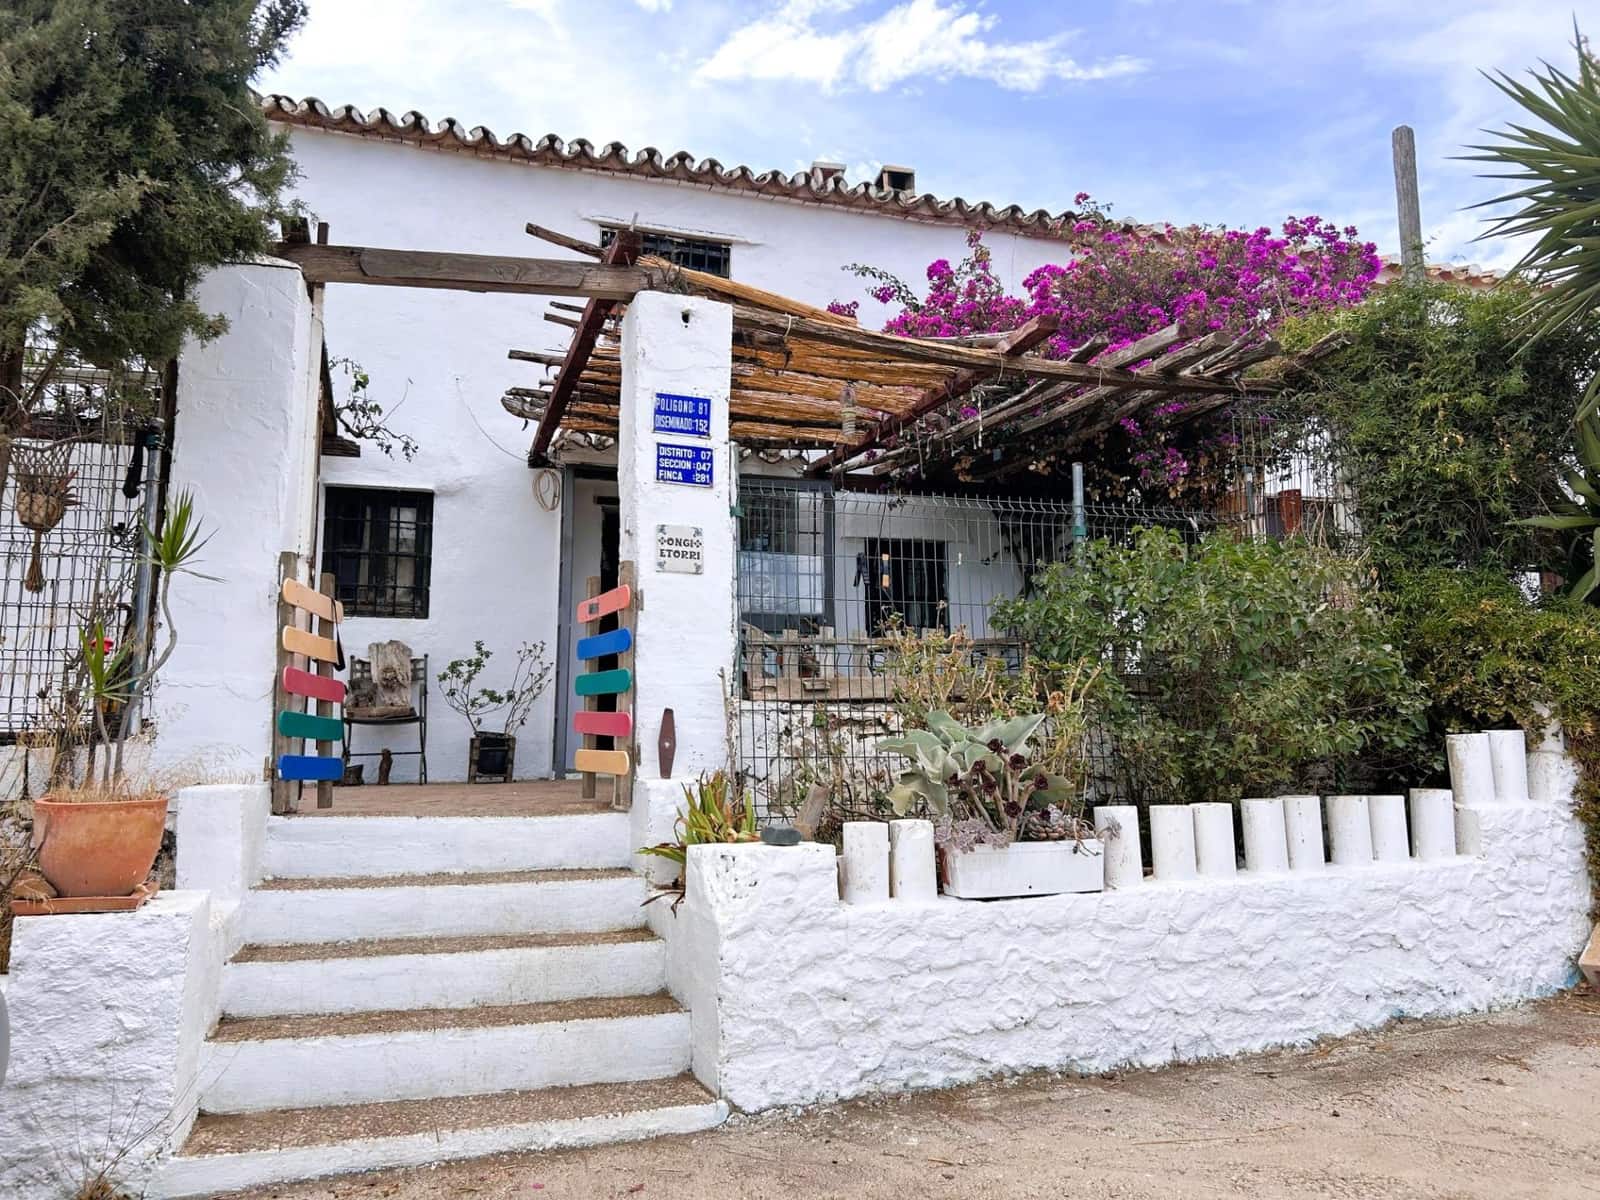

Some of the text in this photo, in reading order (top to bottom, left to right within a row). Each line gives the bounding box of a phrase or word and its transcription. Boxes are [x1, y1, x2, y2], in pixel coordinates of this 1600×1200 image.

[659, 446, 711, 460] DISTRITO: 07
[658, 470, 683, 481] FINCA
[667, 537, 693, 548] ONGI
[659, 549, 700, 560] ETORRI
